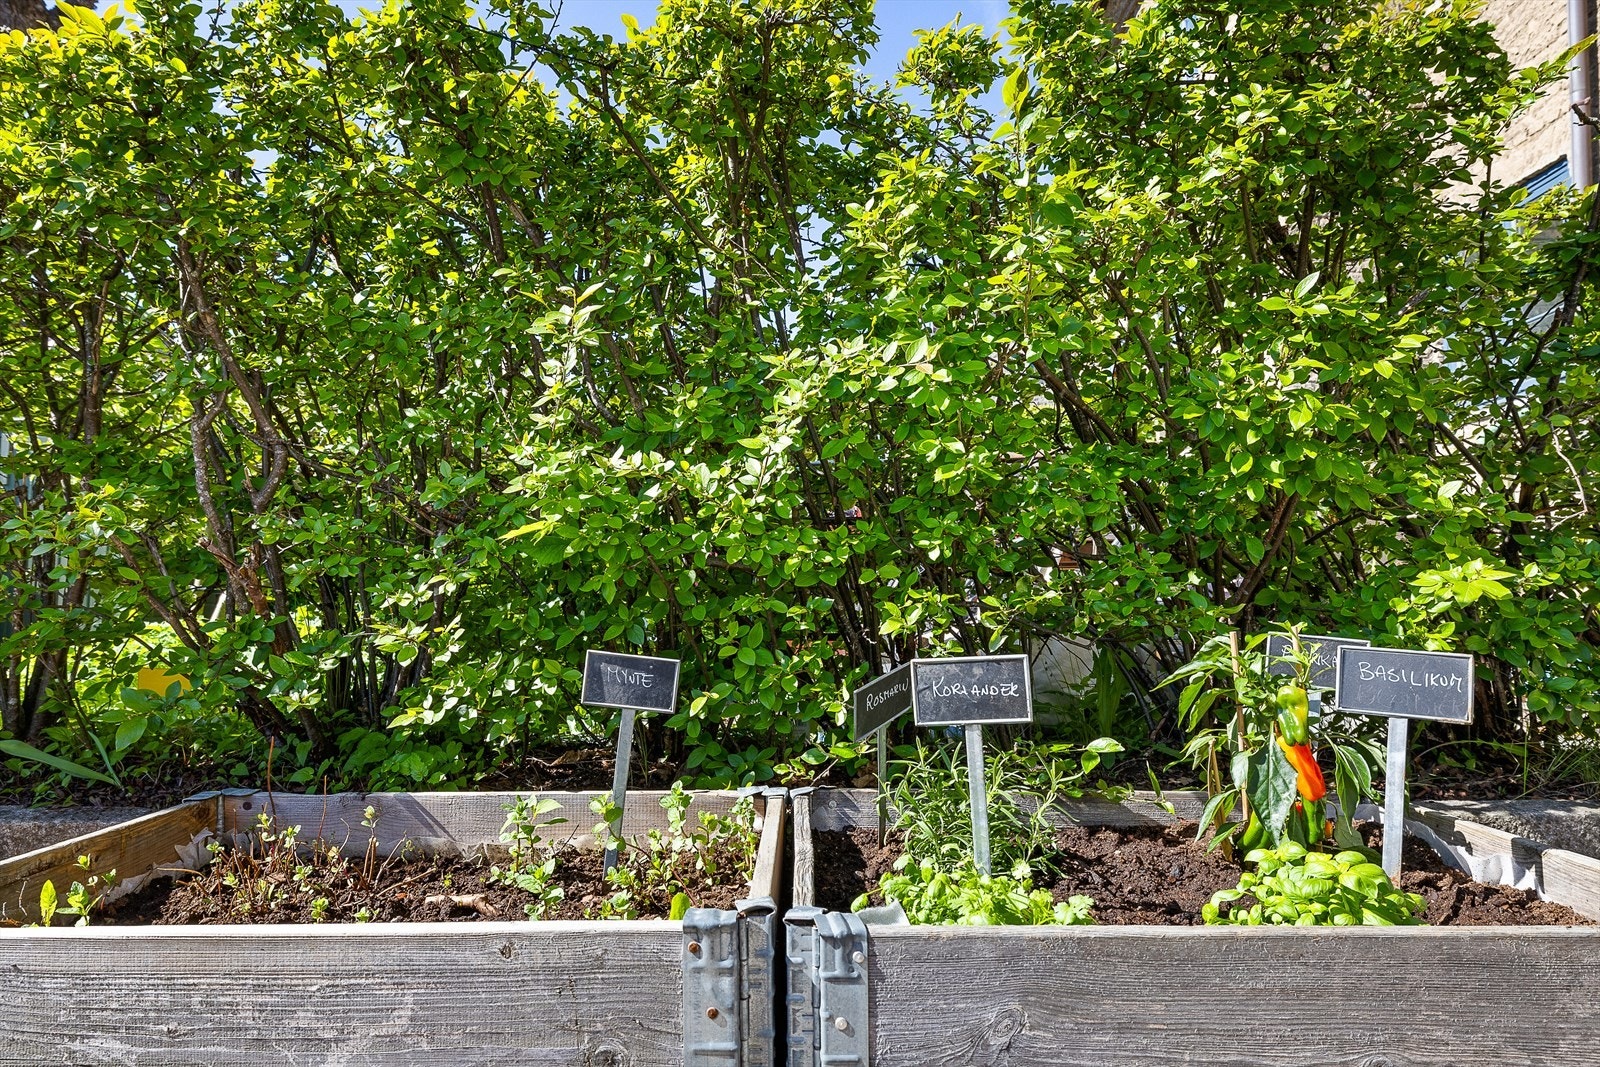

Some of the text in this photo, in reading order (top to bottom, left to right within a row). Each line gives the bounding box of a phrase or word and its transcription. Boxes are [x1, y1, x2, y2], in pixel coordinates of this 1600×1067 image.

[932, 675, 1020, 698] KORIANDER
[1358, 661, 1463, 693] BASILIKUM
[866, 677, 909, 712] ROSMARIN
